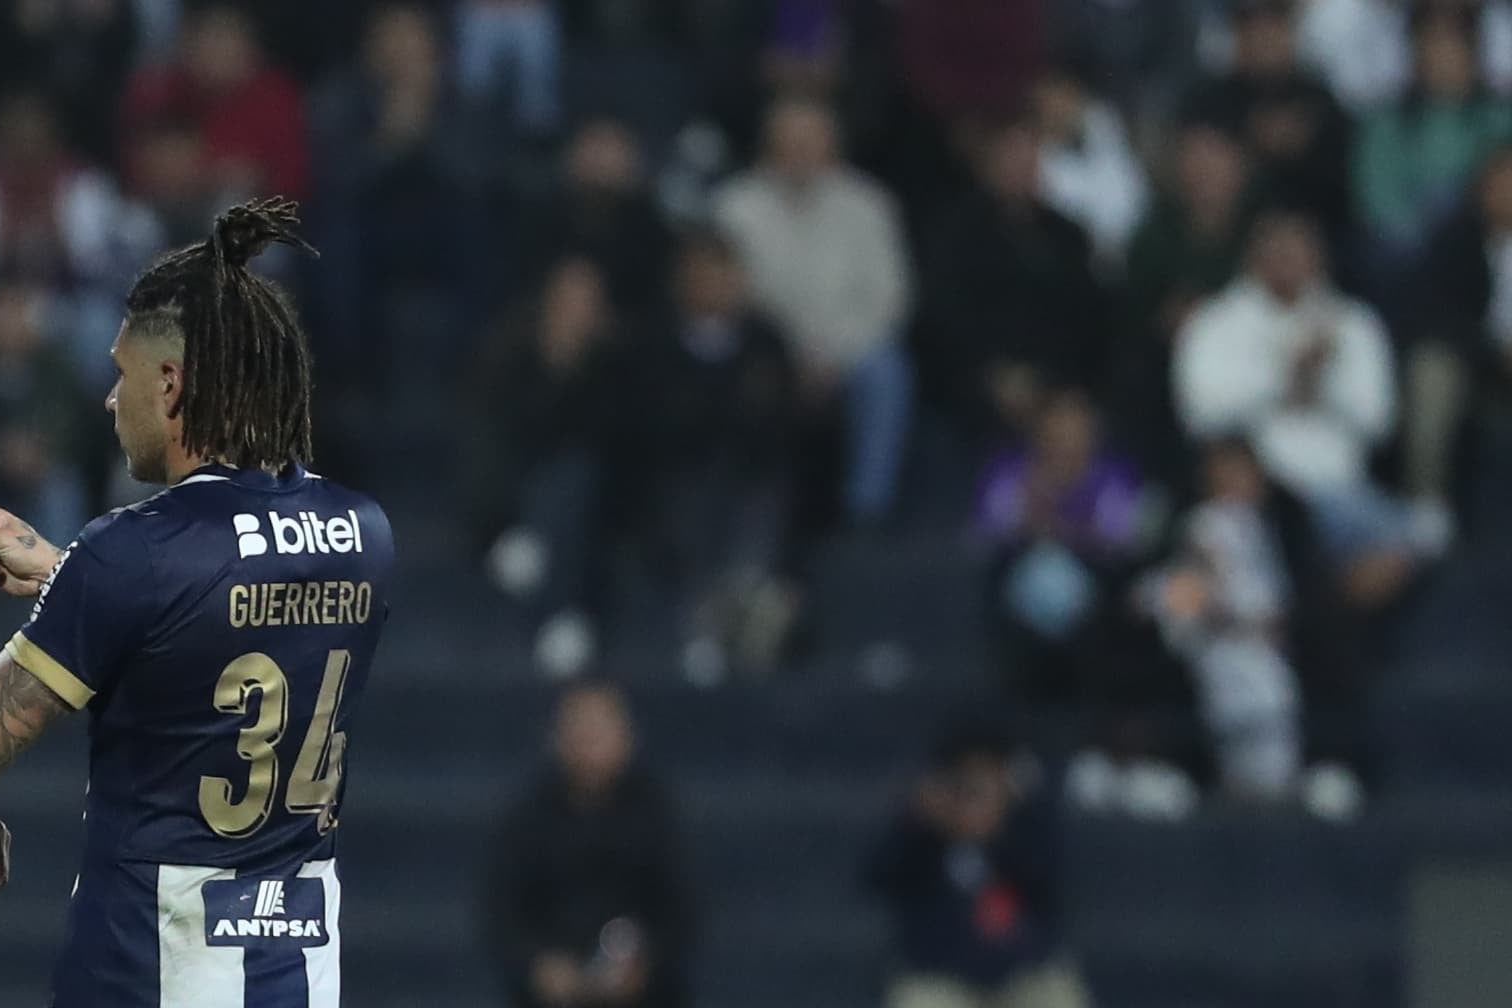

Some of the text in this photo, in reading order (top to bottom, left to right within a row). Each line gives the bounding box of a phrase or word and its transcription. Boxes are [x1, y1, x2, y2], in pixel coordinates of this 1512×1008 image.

[268, 509, 363, 554] bitel
[229, 580, 372, 628] GUERRERO
[198, 649, 351, 840] 34
[213, 918, 321, 937] ANYPSA
